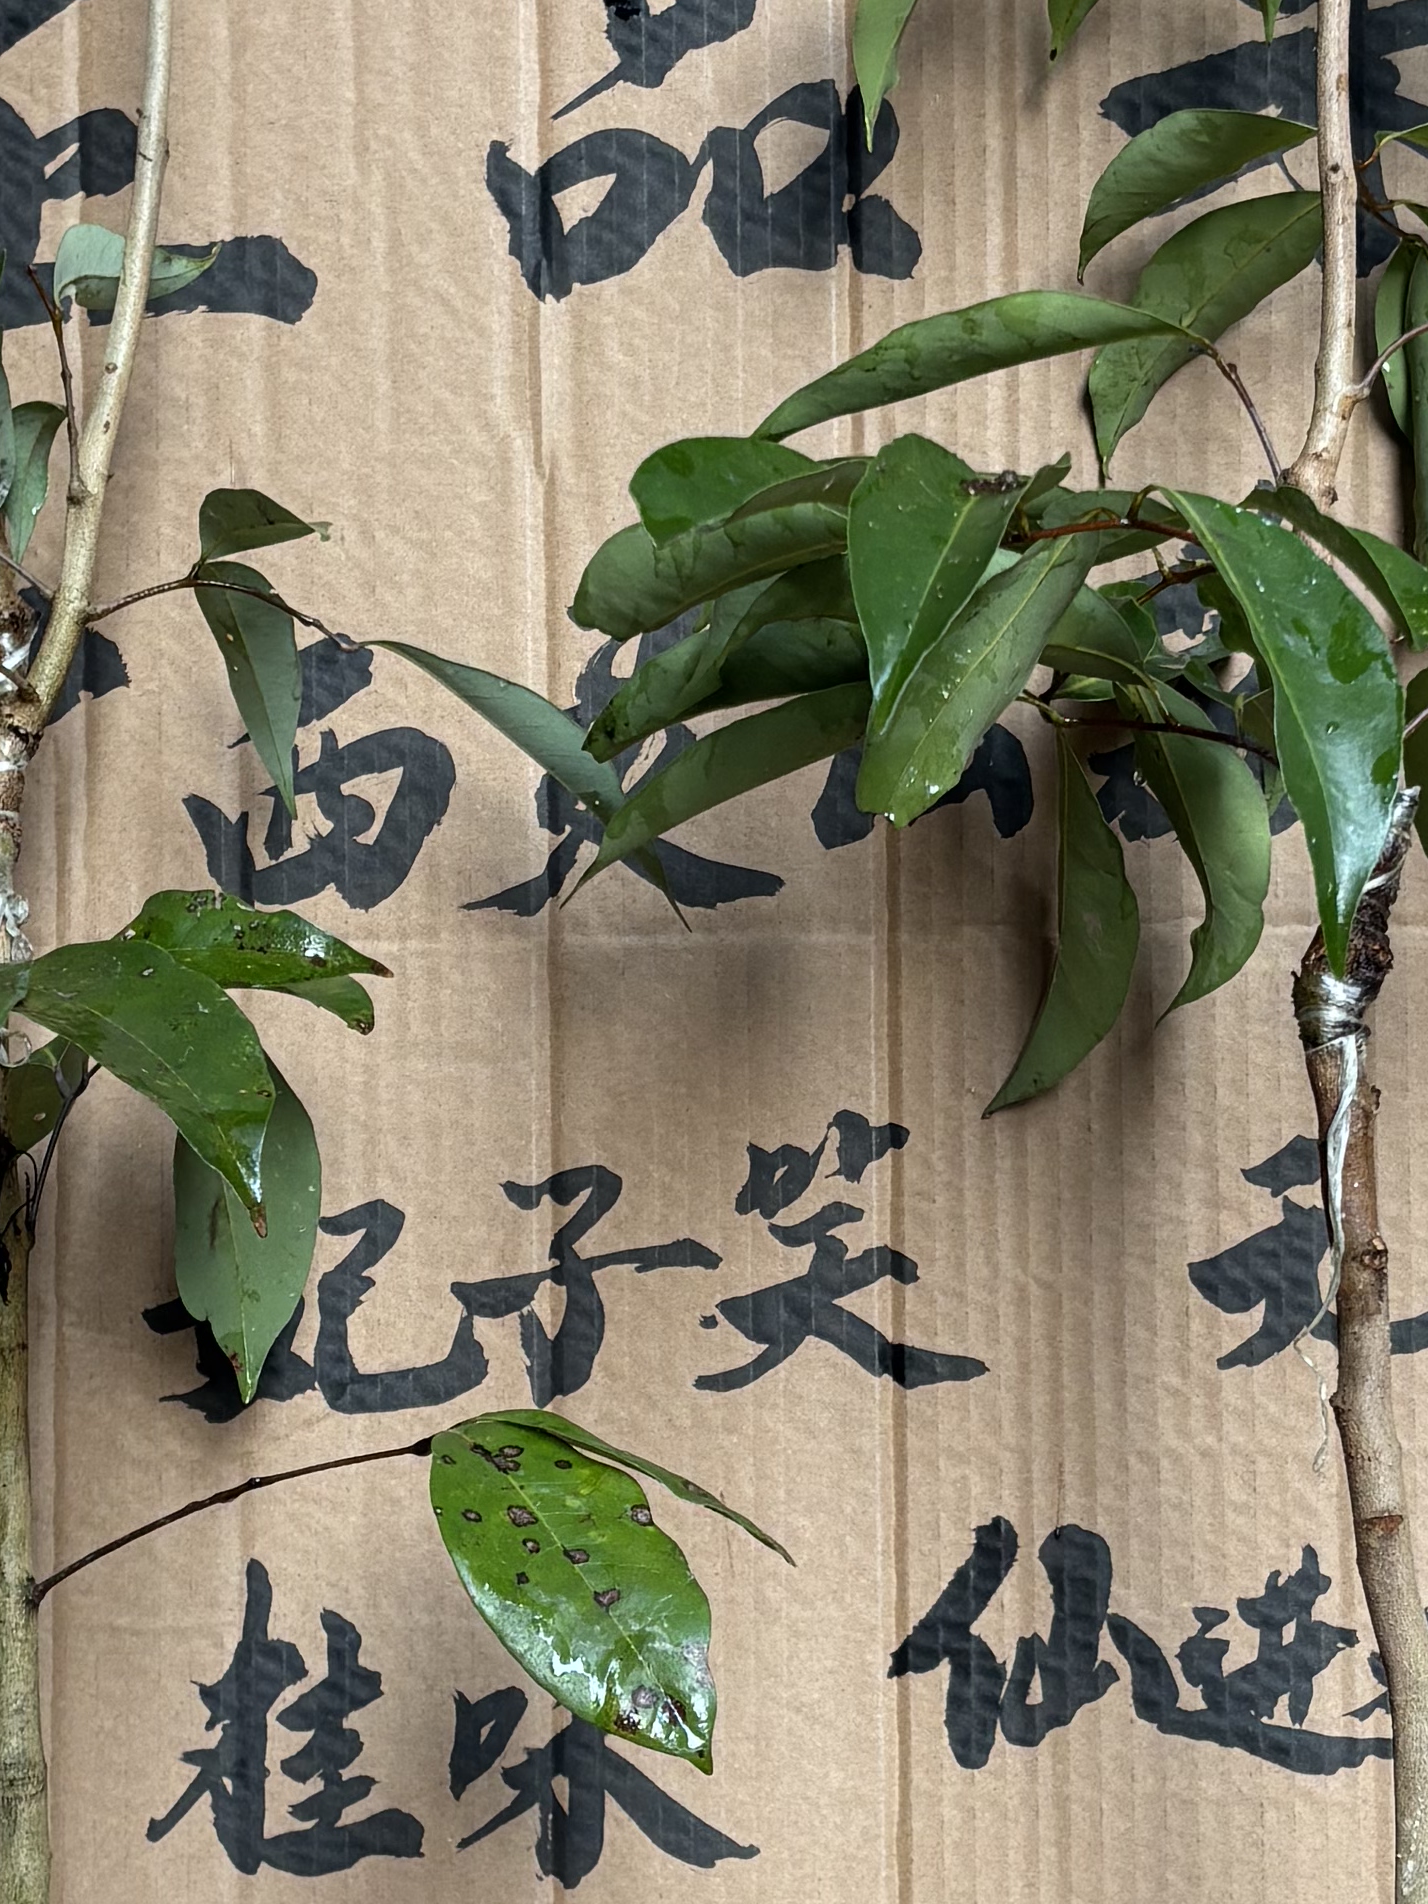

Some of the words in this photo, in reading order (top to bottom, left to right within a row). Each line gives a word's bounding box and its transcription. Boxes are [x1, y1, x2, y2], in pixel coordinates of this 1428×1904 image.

[141, 1109, 990, 1423] 妃子笑
[146, 1557, 761, 1890] 桂味
